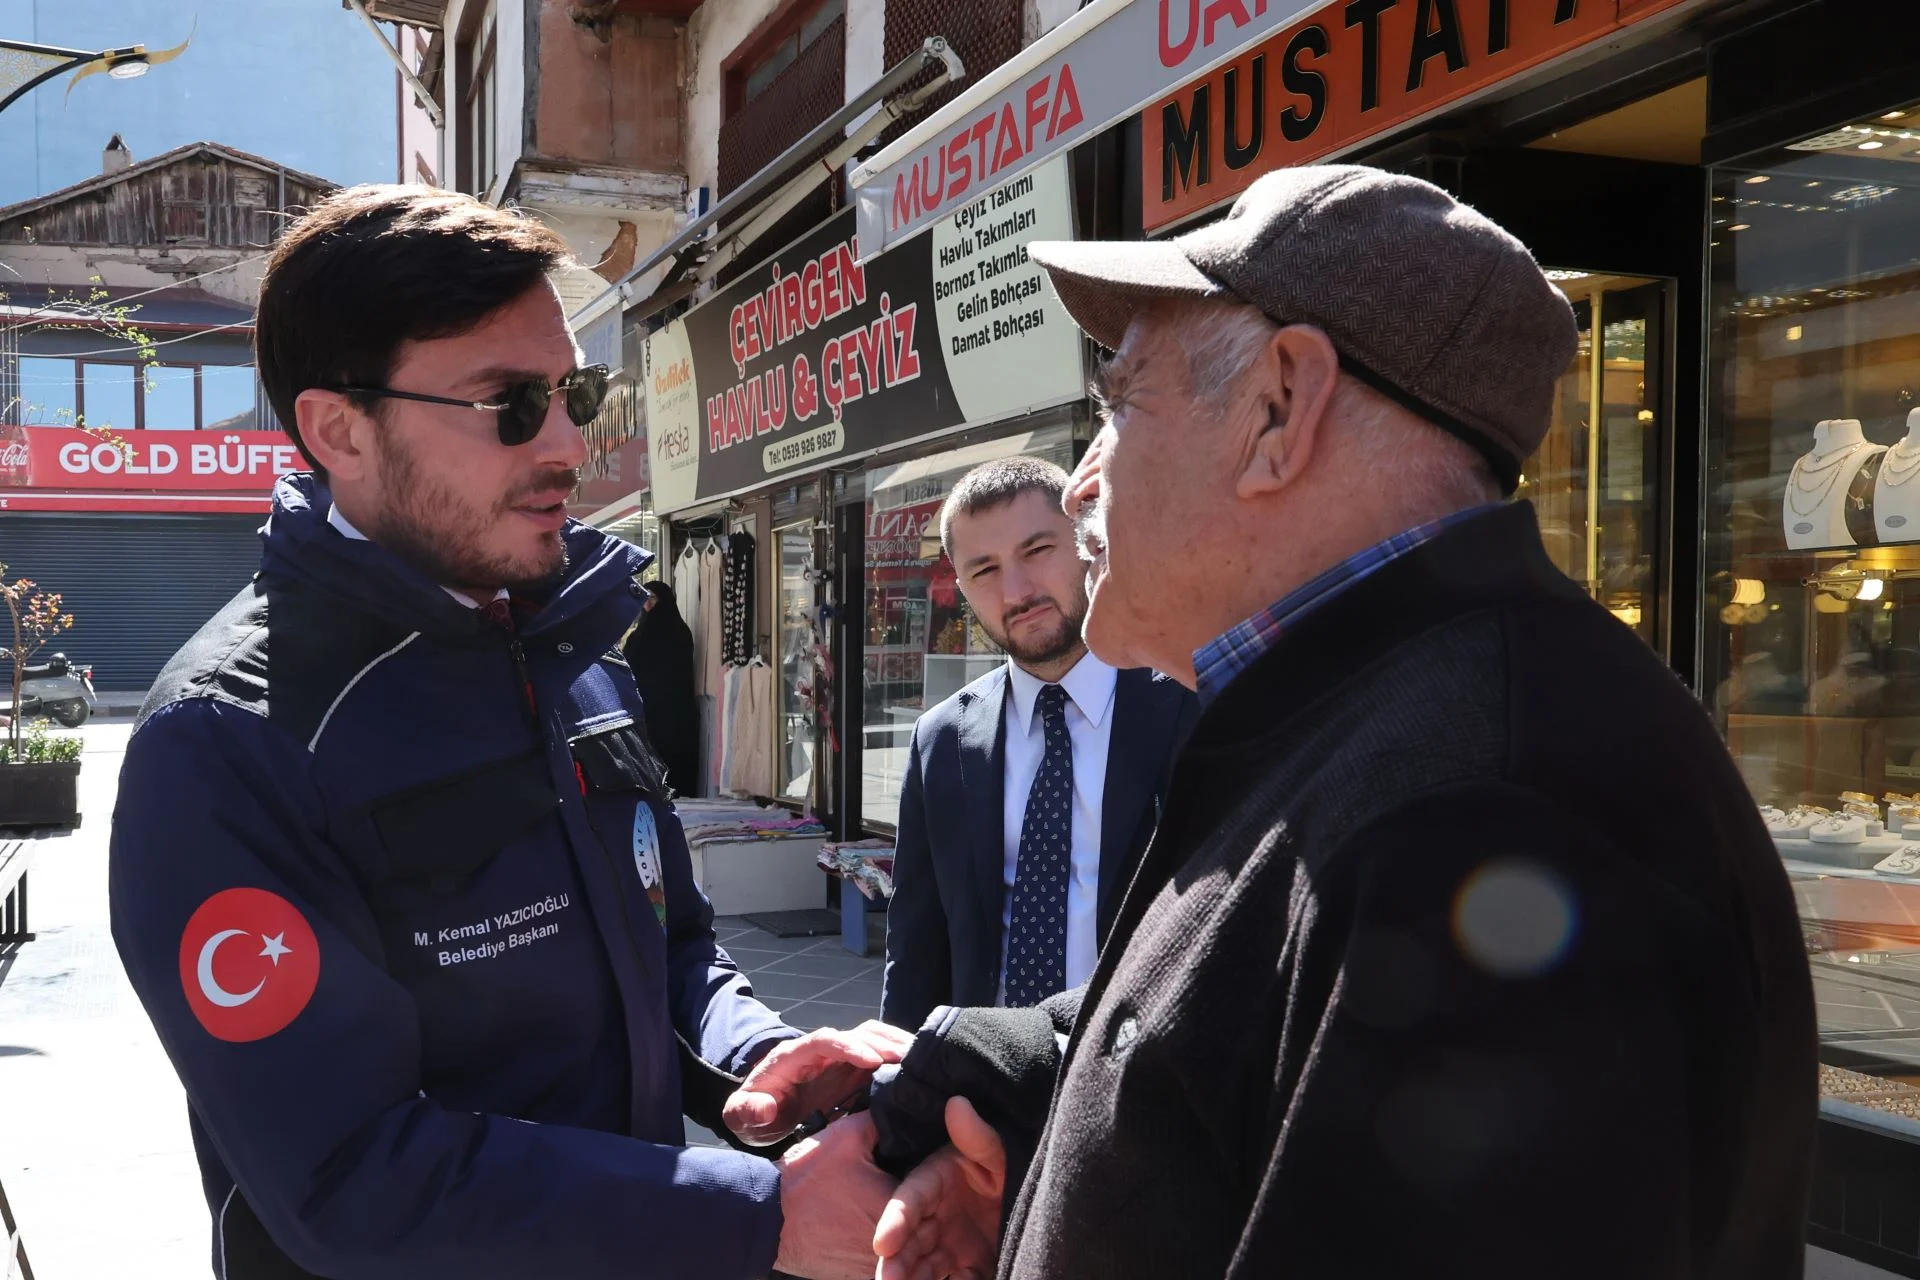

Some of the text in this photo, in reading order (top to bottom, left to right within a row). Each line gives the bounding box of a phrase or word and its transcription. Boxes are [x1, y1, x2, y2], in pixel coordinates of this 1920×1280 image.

[1162, 0, 1579, 202] MUSTA
[893, 63, 1084, 231] MUSTAFA
[989, 174, 1034, 210] Takımı
[940, 208, 1036, 268] Havlu Takımları
[935, 244, 1029, 301] Bornoz Takımla
[957, 275, 1042, 322] Gelin Bohçası
[730, 234, 867, 379] ÇEVİRGEN
[952, 308, 1044, 356] Damat Bohçası
[707, 292, 921, 454] HAVLU & ÇEYİZ
[59, 435, 297, 475] GOLD BÜFE
[782, 442, 799, 461] 0539
[801, 436, 816, 456] 926
[816, 430, 837, 451] 9827
[414, 893, 570, 946] M. Kemal YAZICIOĞLU
[438, 922, 560, 966] Belediye Başkanı
